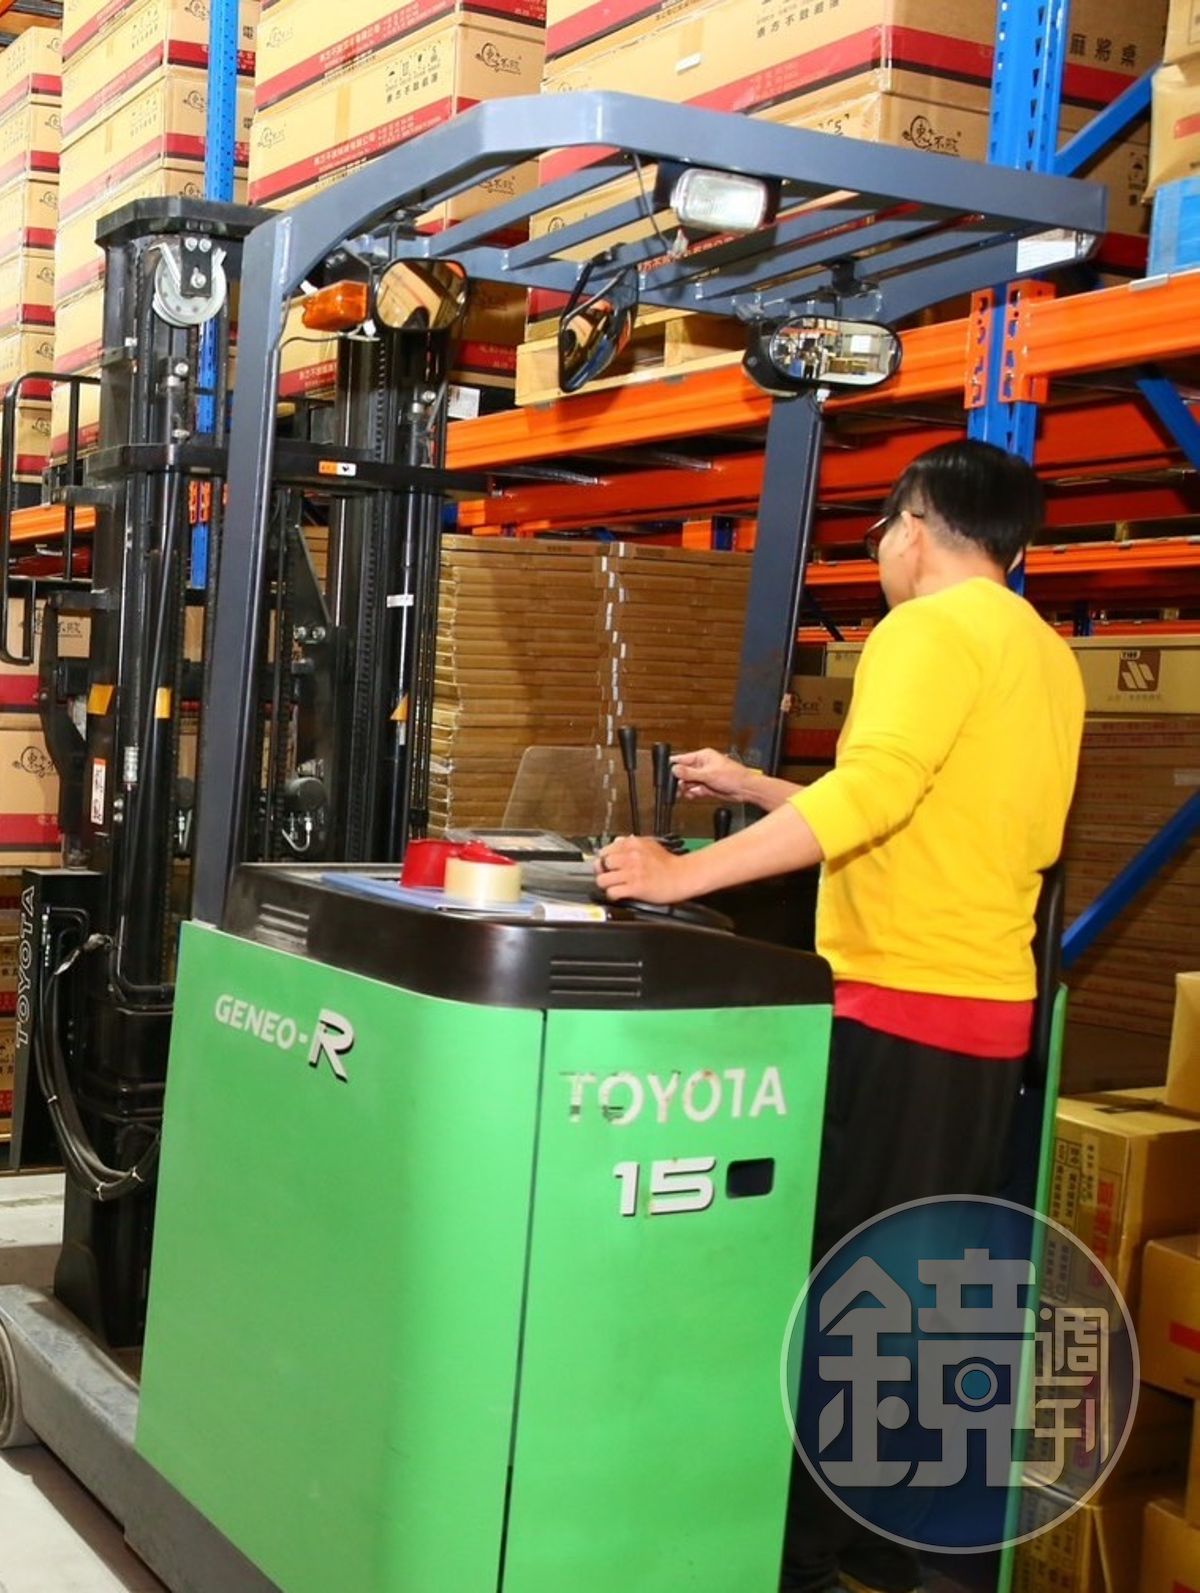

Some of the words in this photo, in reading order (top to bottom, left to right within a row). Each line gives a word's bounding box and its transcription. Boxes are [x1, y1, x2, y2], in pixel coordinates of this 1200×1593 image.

[16, 885, 35, 1048] TOYOTA
[215, 993, 355, 1083] GENEO-R
[560, 1066, 788, 1125] TOYOTA
[612, 1156, 716, 1217] 15
